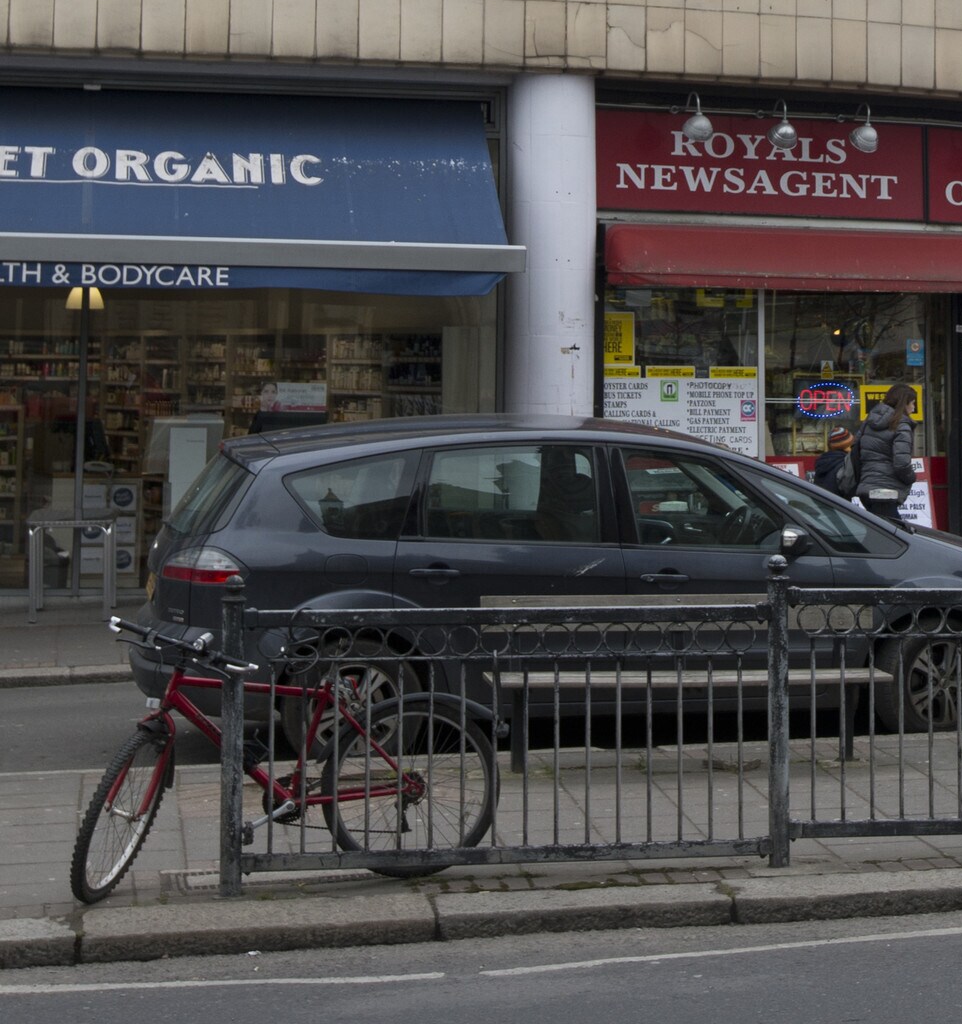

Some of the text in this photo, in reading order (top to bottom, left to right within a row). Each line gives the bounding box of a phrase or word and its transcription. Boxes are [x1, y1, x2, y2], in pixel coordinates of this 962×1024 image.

[72, 146, 324, 186] ORGANIC
[616, 163, 898, 200] NEWSAGENT
[0, 262, 229, 286] TH & BODYCARE
[604, 382, 649, 390] OYSTER CARDS
[689, 382, 732, 390] PHOTOCOPY
[712, 391, 733, 399] PHONE
[734, 391, 745, 399] TOP
[799, 389, 851, 412] OPEN
[604, 410, 630, 418] CALLING
[689, 426, 747, 434] ELECTRIC PAYMENT
